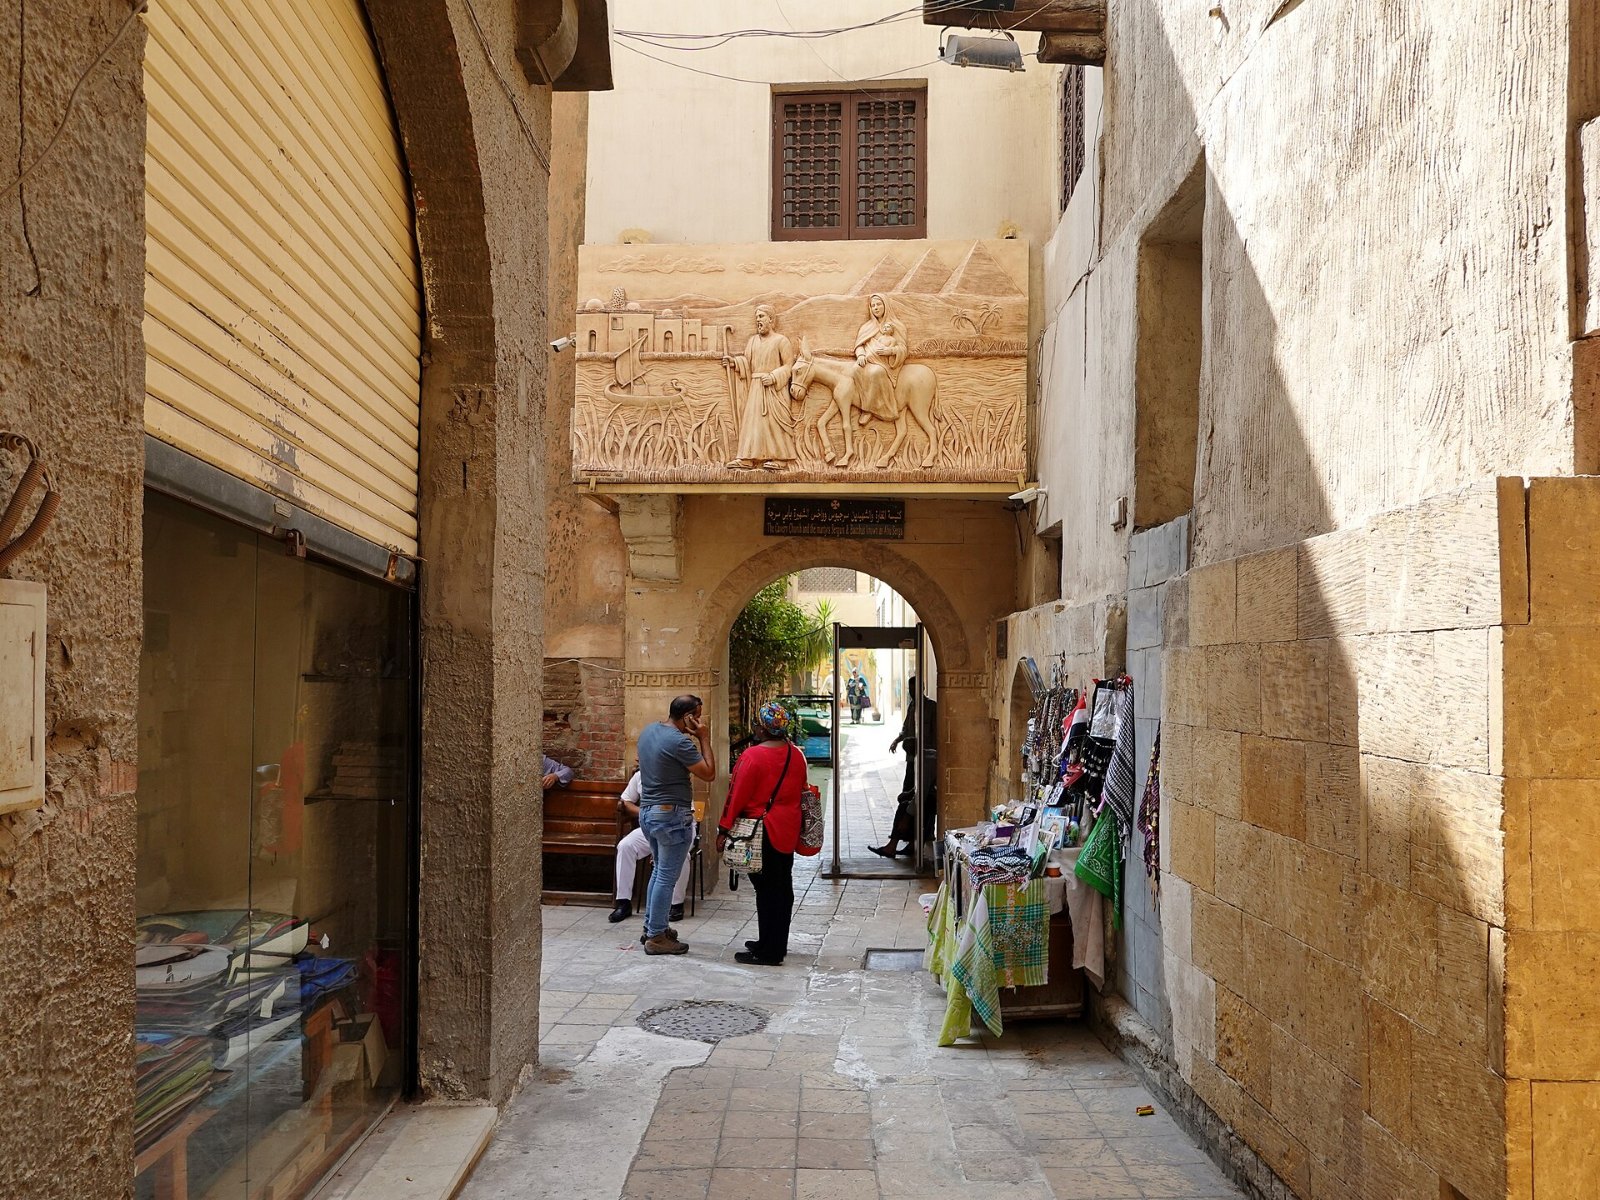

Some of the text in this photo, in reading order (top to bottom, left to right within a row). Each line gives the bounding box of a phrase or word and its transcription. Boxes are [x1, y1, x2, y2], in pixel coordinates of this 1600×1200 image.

[793, 507, 809, 521] الشهيرة
[828, 511, 849, 523] سرجيوس
[850, 508, 874, 524] والشهيدين
[874, 509, 887, 524] المغارة
[888, 509, 903, 524] كنيسة
